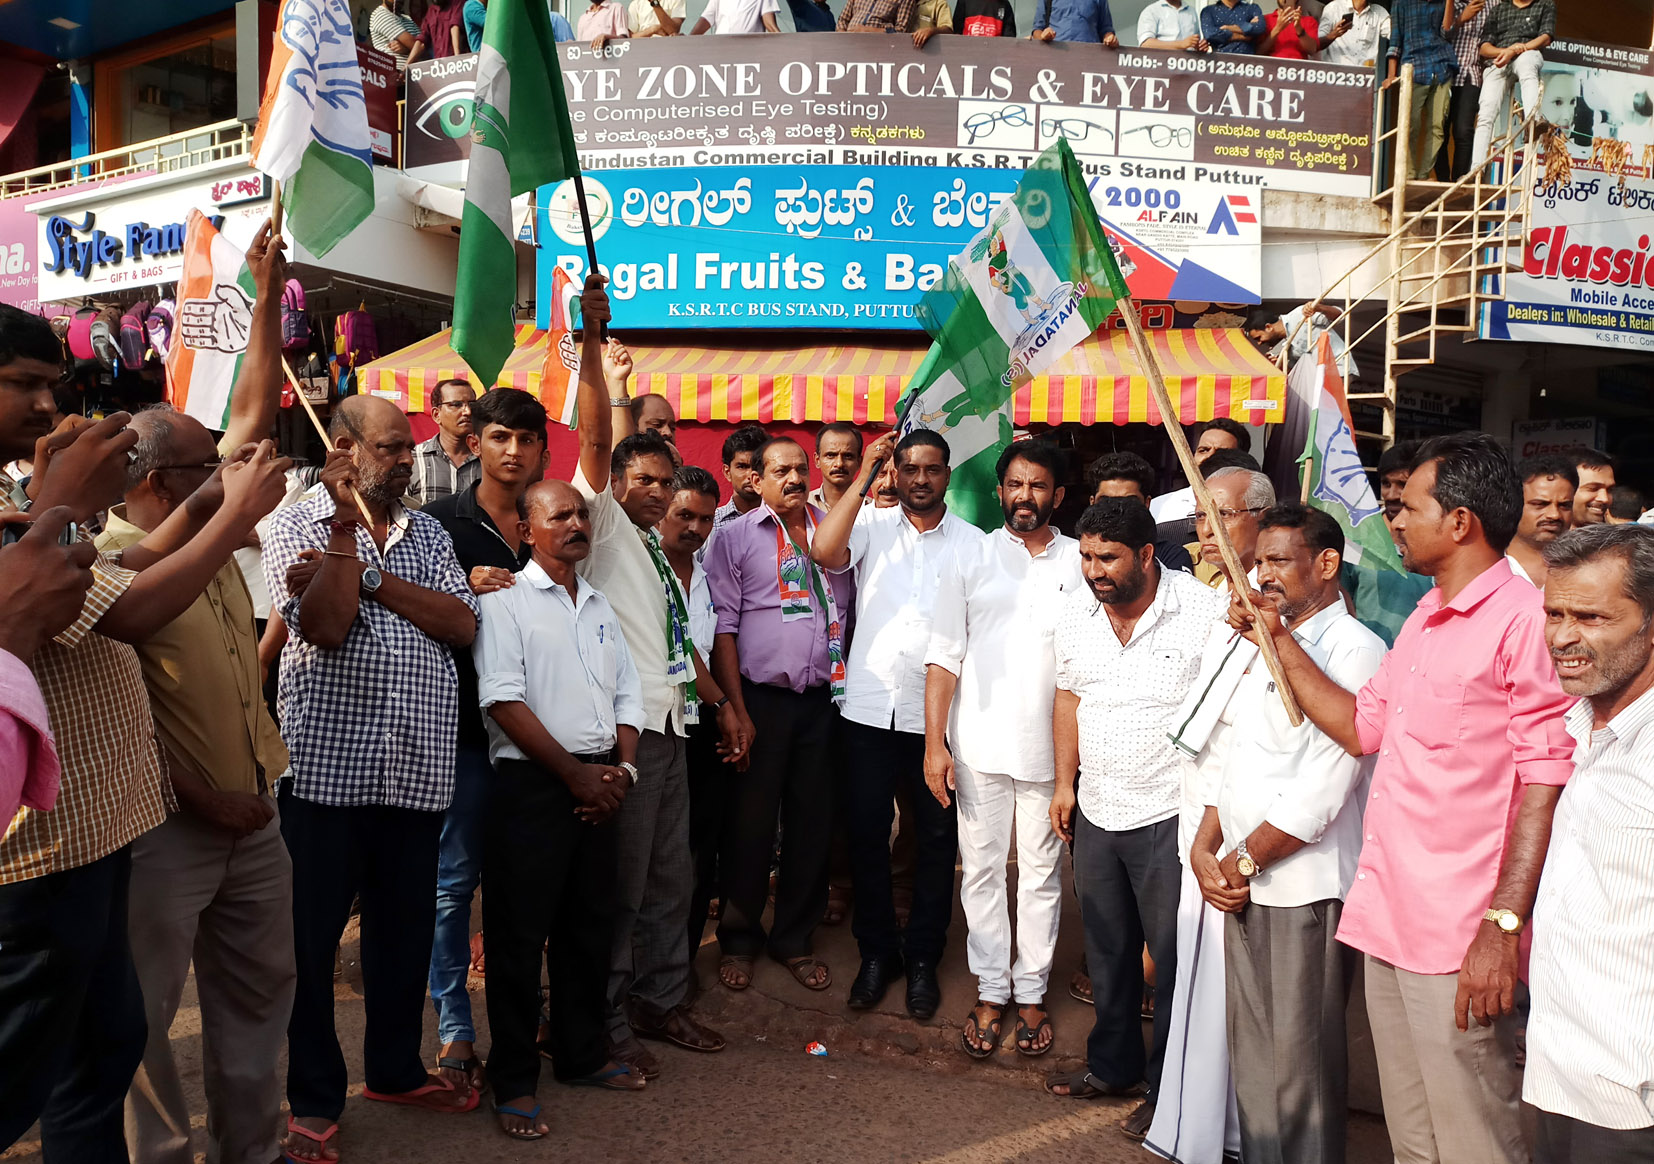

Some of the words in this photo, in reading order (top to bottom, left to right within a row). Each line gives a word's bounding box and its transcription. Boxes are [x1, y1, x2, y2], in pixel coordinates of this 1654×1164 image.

[1546, 40, 1567, 52] ONE
[1568, 43, 1605, 57] OPTICALS
[1605, 48, 1612, 58] &
[1613, 50, 1628, 61] EYE
[1628, 52, 1649, 64] CARE
[1167, 57, 1265, 78] 9008123466
[1276, 66, 1376, 87] 8618902337
[562, 69, 621, 102] YE
[636, 63, 762, 100] ZONE
[778, 61, 1014, 101] OPTICALS
[1029, 68, 1065, 104] &
[1079, 71, 1170, 112] EYE
[1186, 80, 1305, 122] CARE
[593, 101, 743, 123] Computerised
[752, 101, 793, 120] Eye
[800, 100, 888, 120] Testing)
[850, 124, 926, 144] ಕನ್ನಡಕಗಳು
[578, 153, 685, 169] Hindustan
[693, 150, 834, 165] Commercial
[843, 150, 938, 167] Building
[1120, 162, 1186, 181] Stand
[1194, 168, 1268, 187] Puttur.
[621, 177, 753, 228] ರೀಗಲ್
[890, 193, 917, 227] &
[1105, 186, 1181, 210] 2000
[44, 210, 120, 278] Style
[17, 275, 31, 288] Day
[110, 272, 128, 284] GIFT
[132, 270, 138, 280] &
[141, 266, 164, 279] BAGS
[695, 252, 826, 291] Fruits
[841, 261, 868, 290] &
[1570, 287, 1617, 306] Mobile
[668, 303, 743, 317] K.S.R.T.C
[747, 303, 781, 316] BUS
[785, 303, 849, 319] STAND,
[1507, 303, 1549, 322] Dealers
[1551, 307, 1564, 321] in:
[1566, 309, 1617, 328] Wholesale
[1619, 313, 1627, 329] &
[1595, 332, 1638, 345] K.S.R.T.C.
